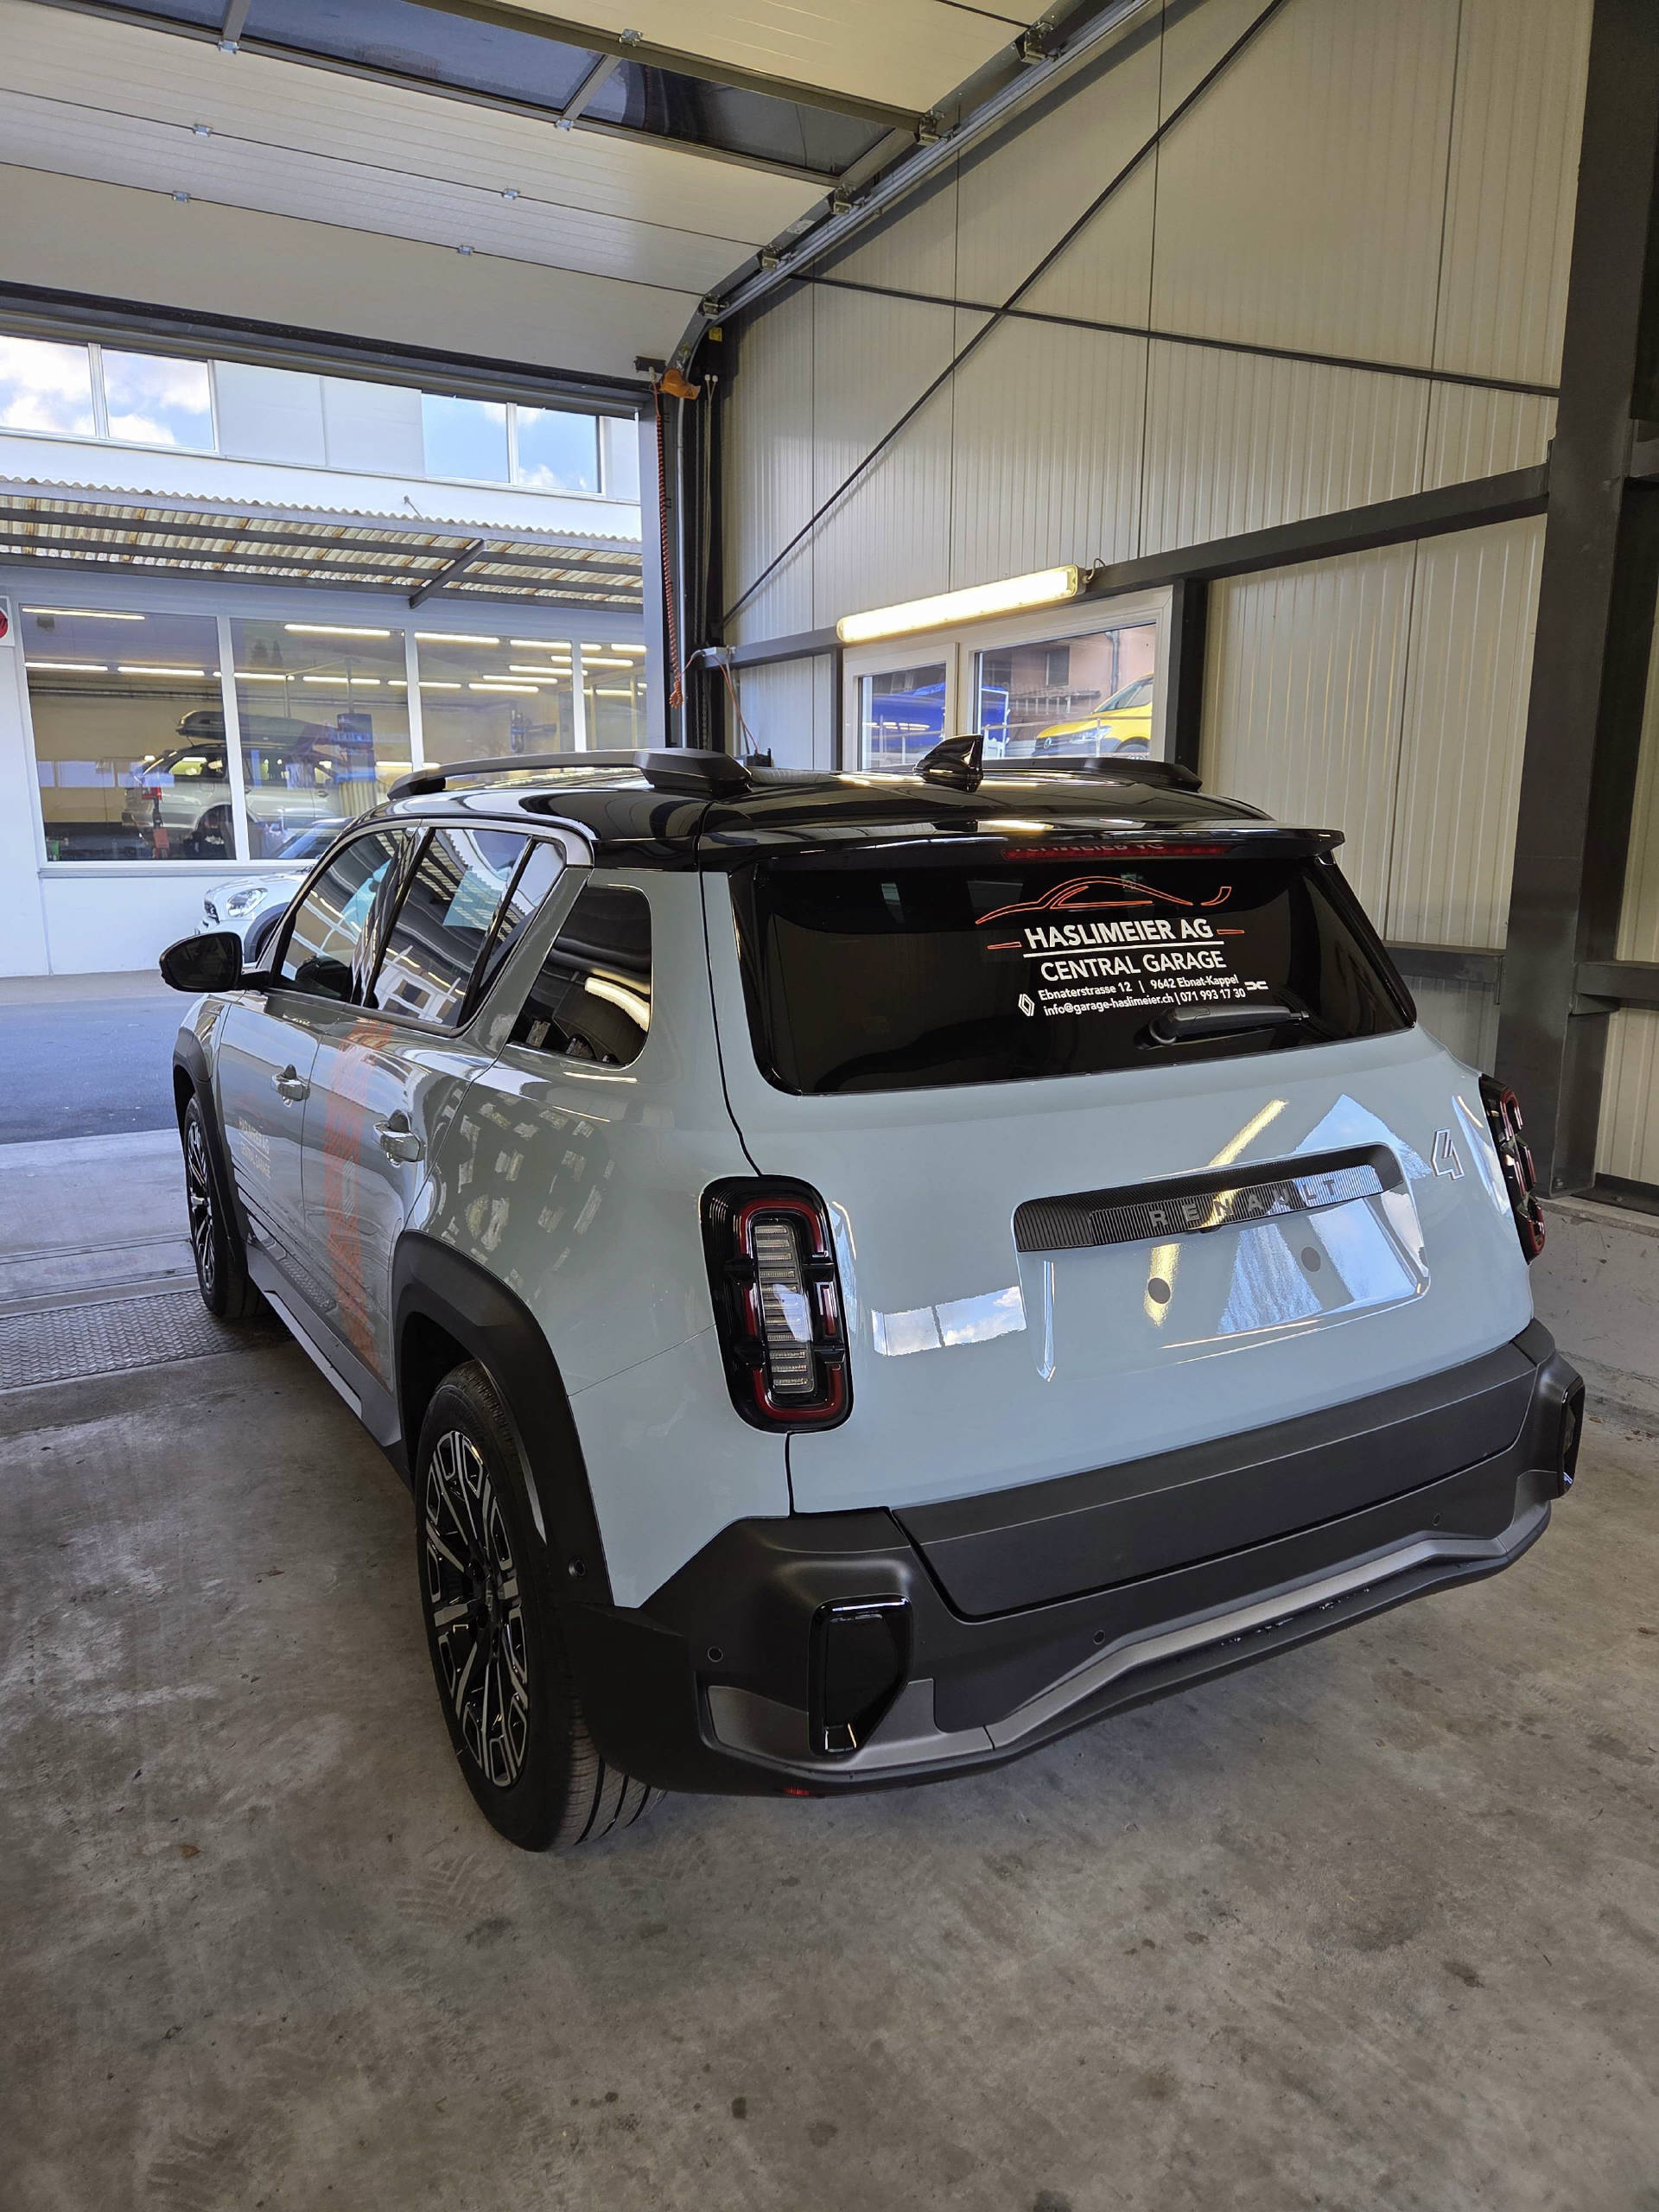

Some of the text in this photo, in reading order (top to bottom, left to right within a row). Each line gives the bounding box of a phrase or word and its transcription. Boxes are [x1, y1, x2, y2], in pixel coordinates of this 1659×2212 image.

[1024, 918, 1214, 949] HASLIMEIER AG
[1040, 950, 1227, 982] CENTRAL GARAGE
[1038, 985, 1116, 1001] Ebnaterstrasse
[1118, 982, 1133, 993] 12
[1150, 978, 1177, 989] 9642
[1176, 974, 1239, 988] Ebnat-Kappel
[1043, 993, 1175, 1016] info@garage-haslimeier.ch
[1179, 991, 1199, 1002] 071
[1200, 989, 1219, 1001] 993
[1219, 988, 1231, 999] 17
[1233, 988, 1246, 998] 30
[1431, 1128, 1465, 1181] 4
[1150, 1179, 1335, 1227] RENAULT
